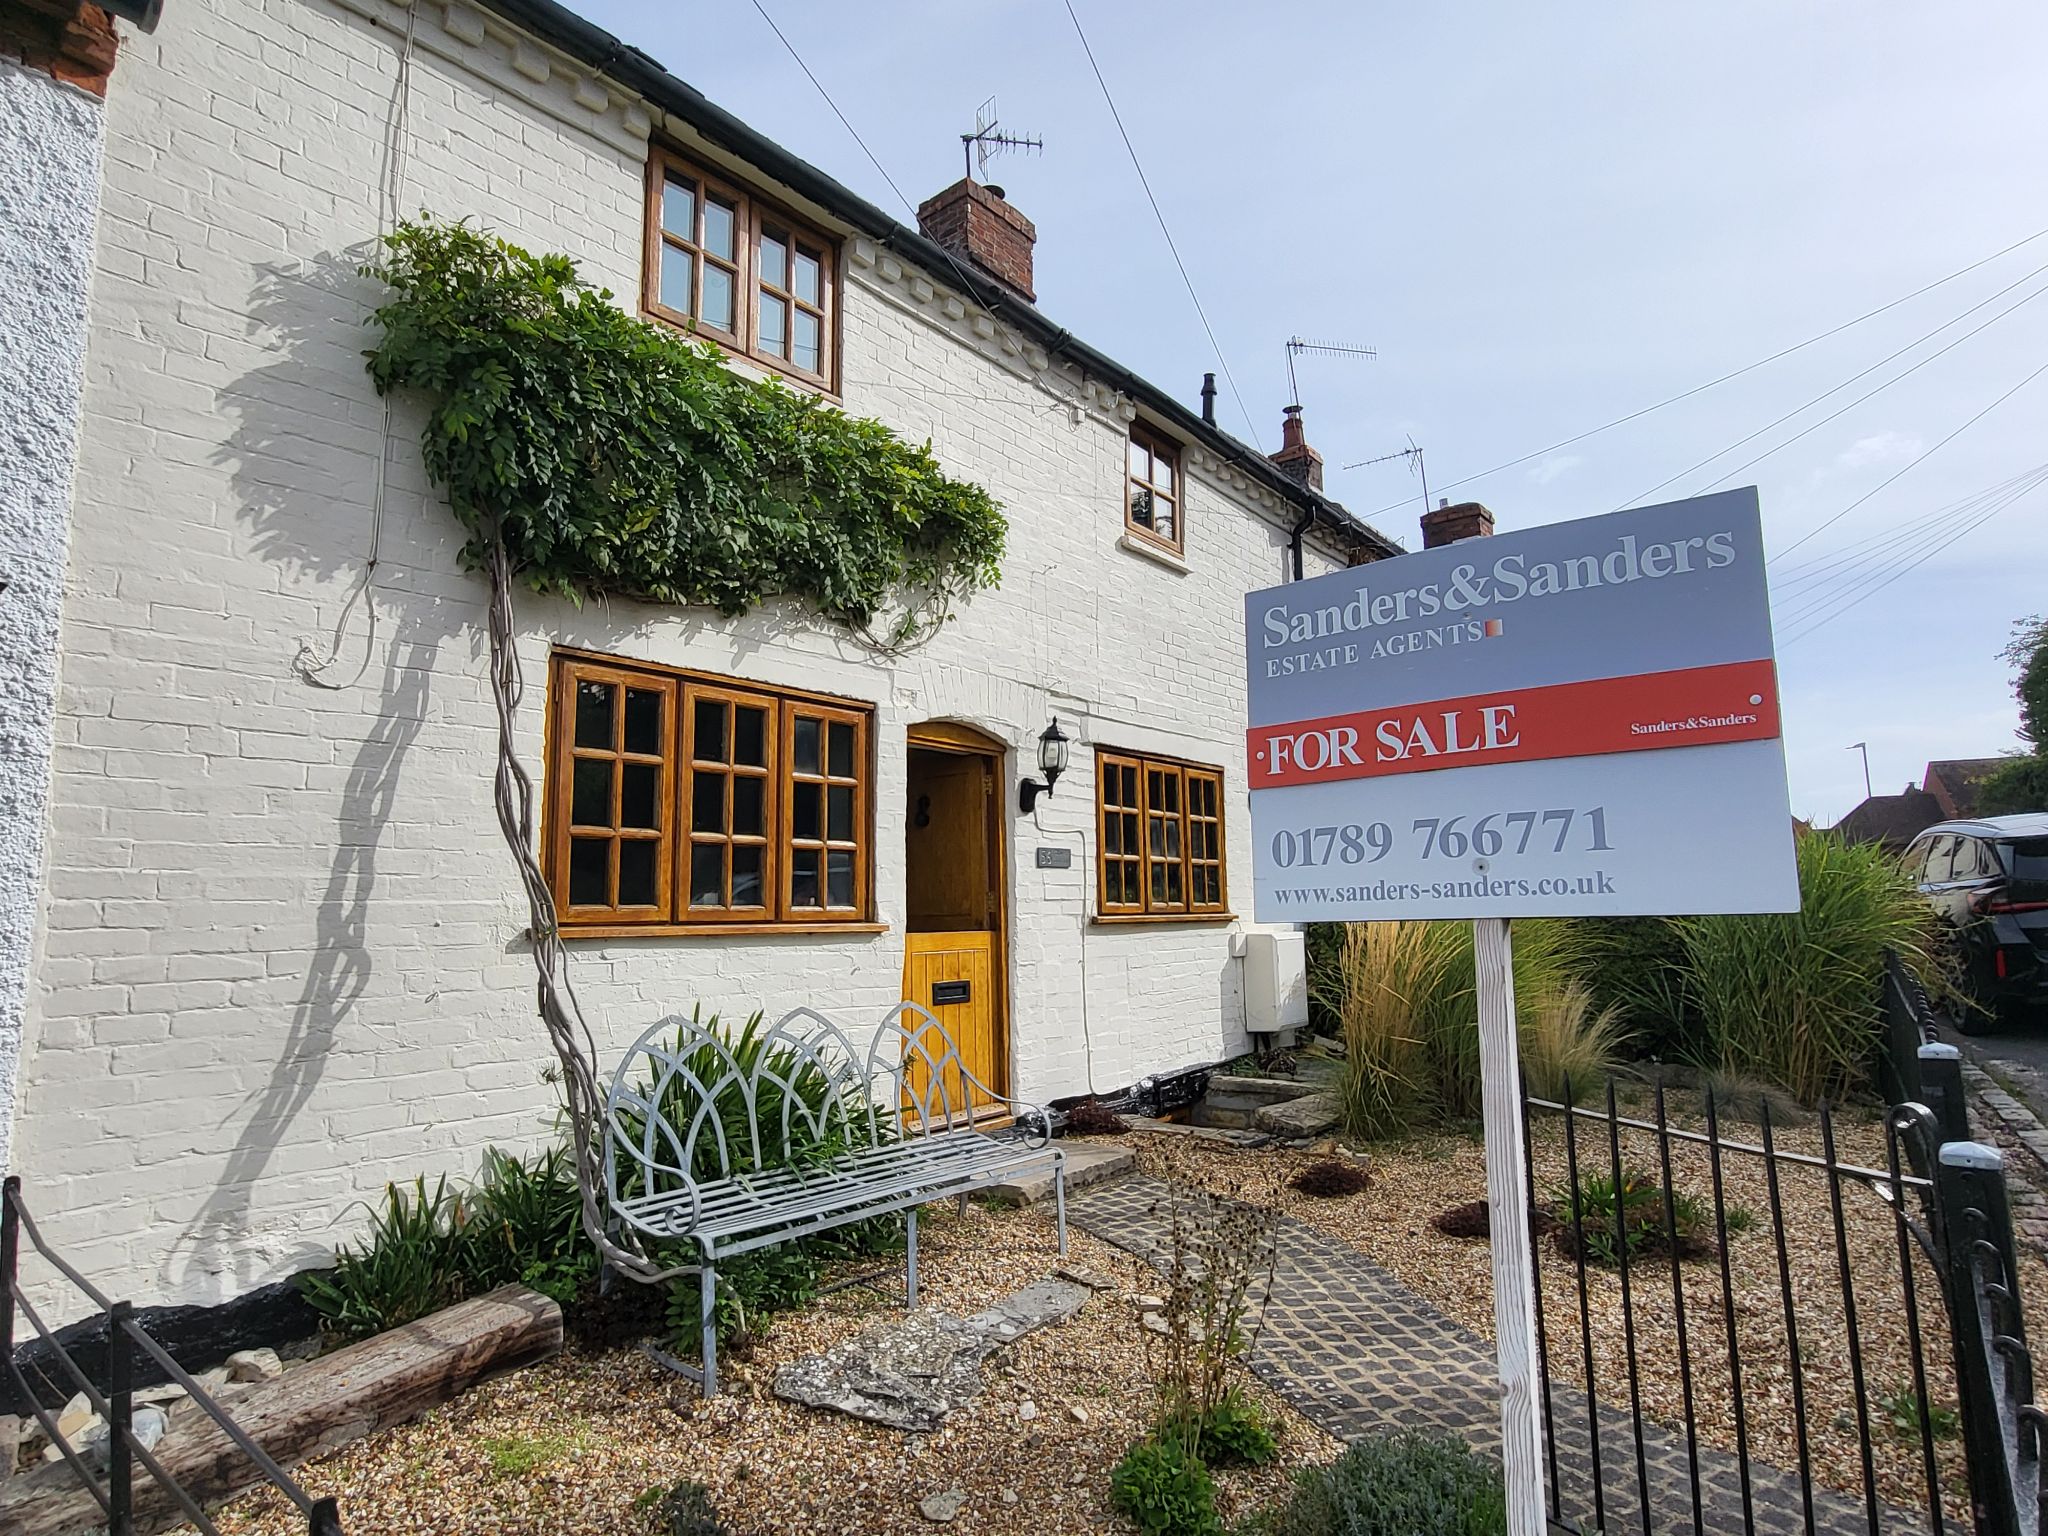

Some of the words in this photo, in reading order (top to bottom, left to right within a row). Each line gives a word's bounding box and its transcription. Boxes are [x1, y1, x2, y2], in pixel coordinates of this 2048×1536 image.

[1263, 531, 1735, 648] Sanders&Sanders
[1266, 645, 1359, 678] ESTATE
[1371, 621, 1483, 659] AGENTS
[1266, 727, 1363, 775] FOR
[1376, 704, 1520, 763] SALE
[1631, 713, 1757, 735] Sanders&Sanders
[1271, 822, 1393, 868] 01789
[1412, 806, 1616, 860] 766771
[1275, 871, 1616, 904] www.sanders-sanders.co.uk
